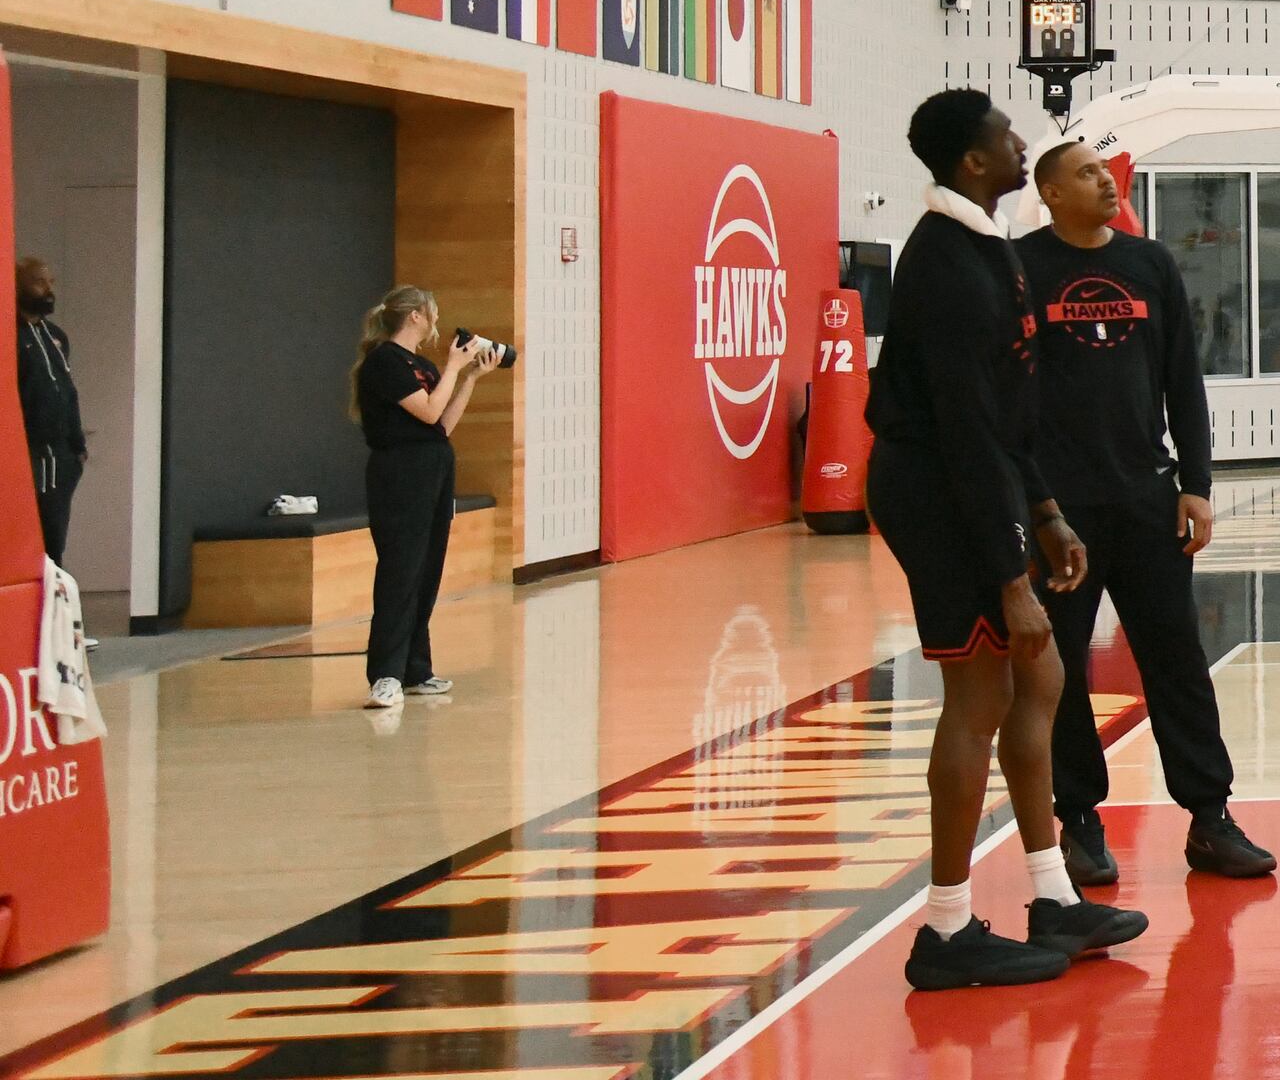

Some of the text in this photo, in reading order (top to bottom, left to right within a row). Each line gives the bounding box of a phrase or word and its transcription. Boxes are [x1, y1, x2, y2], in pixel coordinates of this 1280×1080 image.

[694, 265, 787, 359] HAWKS
[1062, 302, 1134, 318] HAWKS
[820, 340, 853, 372] 72
